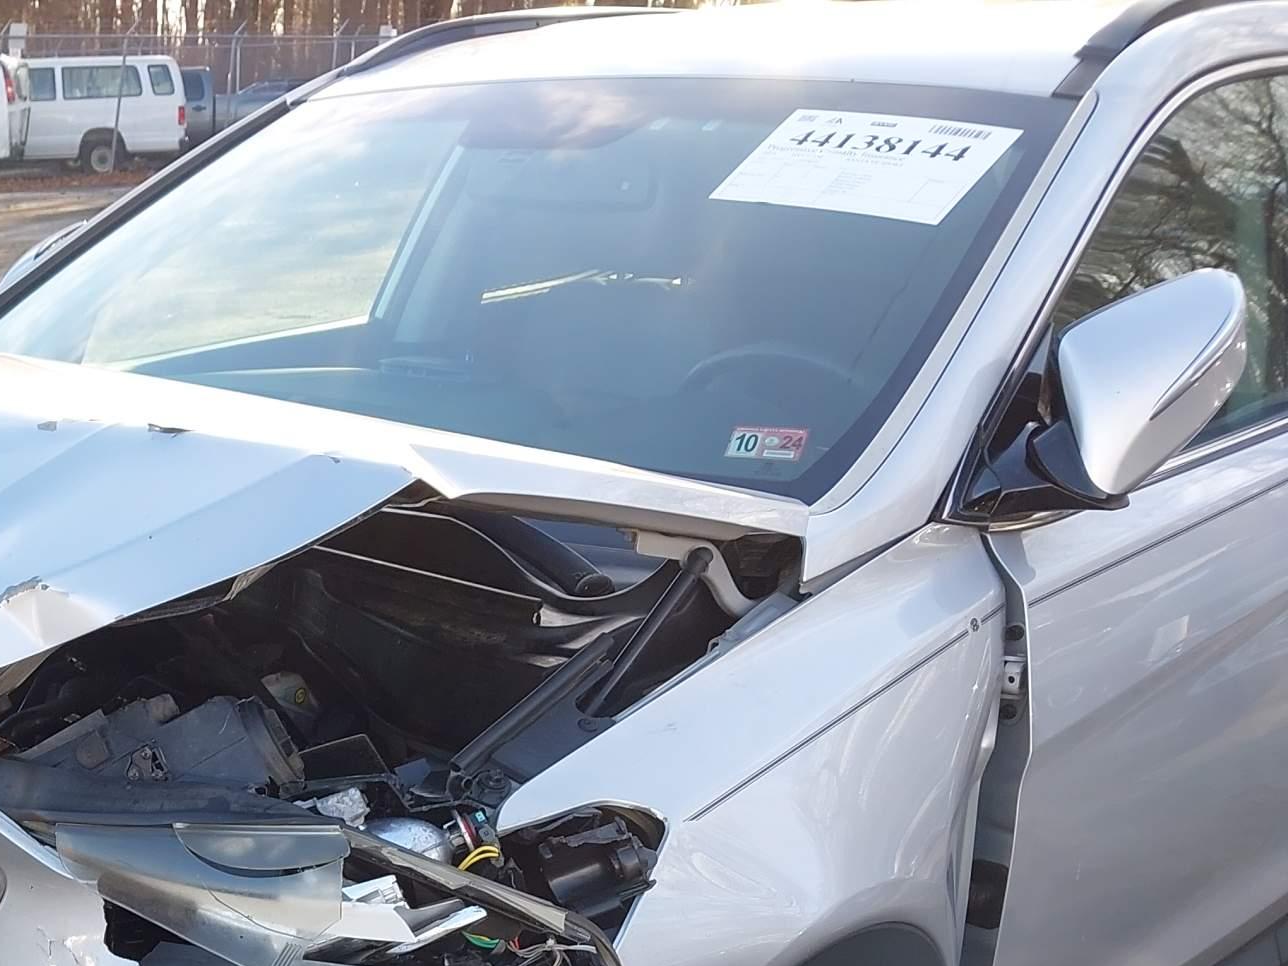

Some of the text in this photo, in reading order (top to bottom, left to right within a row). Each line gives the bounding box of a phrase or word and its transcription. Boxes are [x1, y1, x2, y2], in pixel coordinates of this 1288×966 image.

[789, 130, 971, 161] 44138144
[735, 433, 803, 452] 10 24
